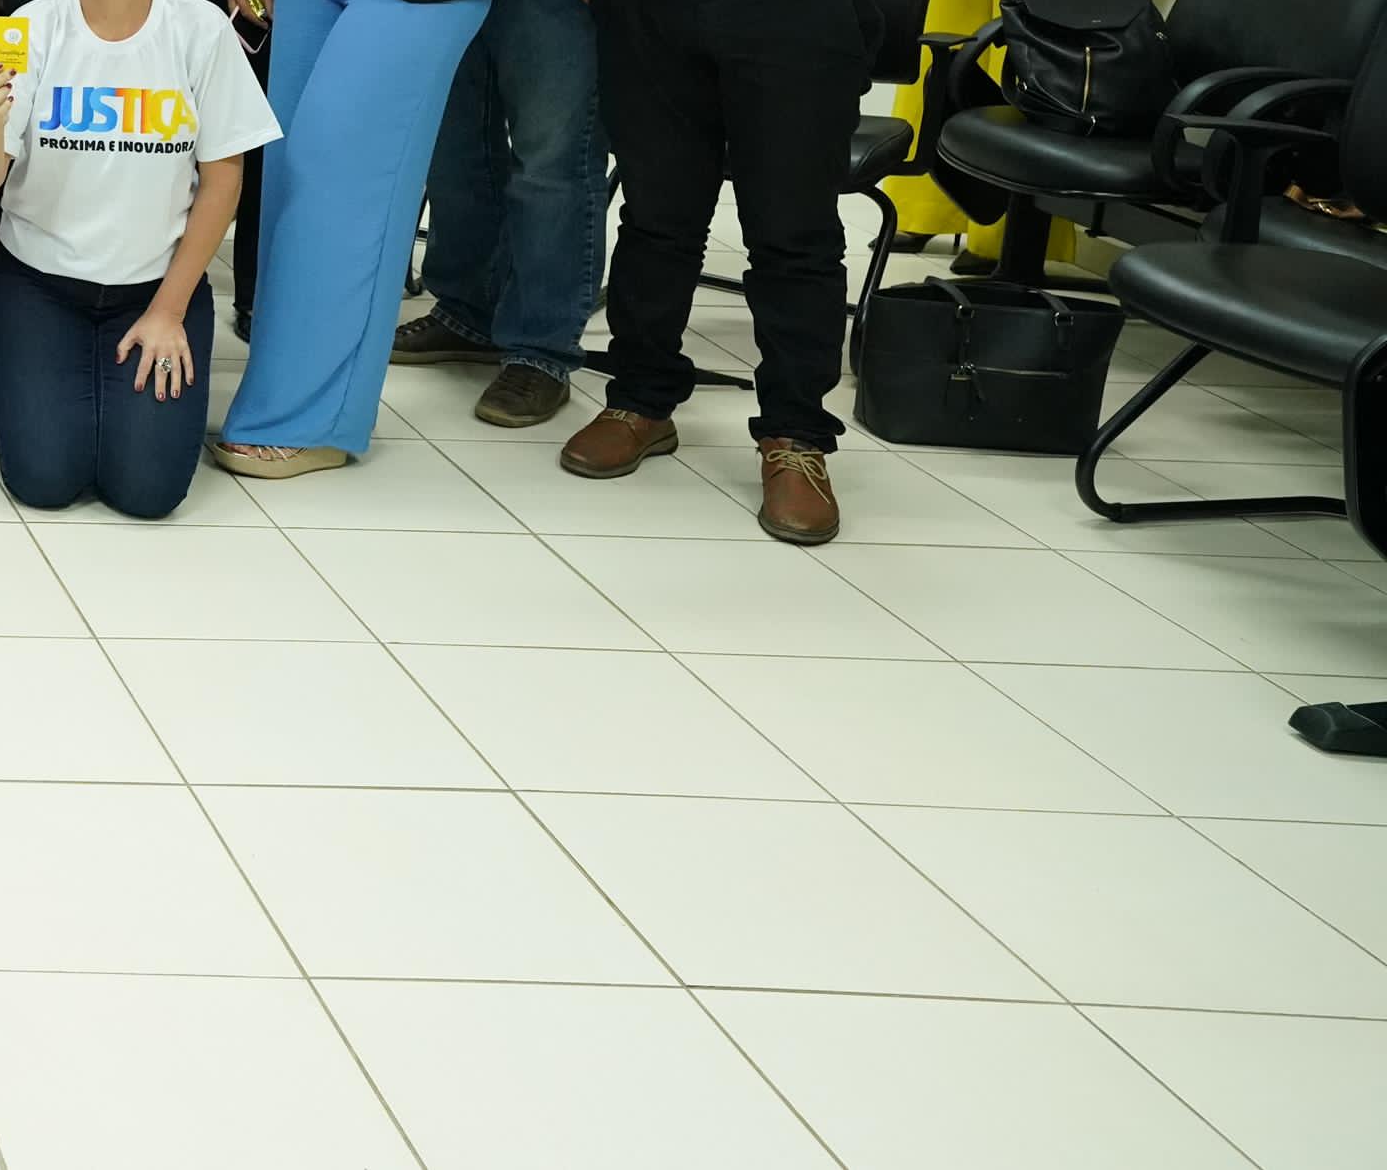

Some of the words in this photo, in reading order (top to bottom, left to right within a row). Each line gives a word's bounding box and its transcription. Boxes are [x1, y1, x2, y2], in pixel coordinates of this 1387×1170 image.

[39, 86, 197, 142] JUSTIÇA
[40, 137, 106, 152] PRÓXIMA
[109, 141, 115, 152] E
